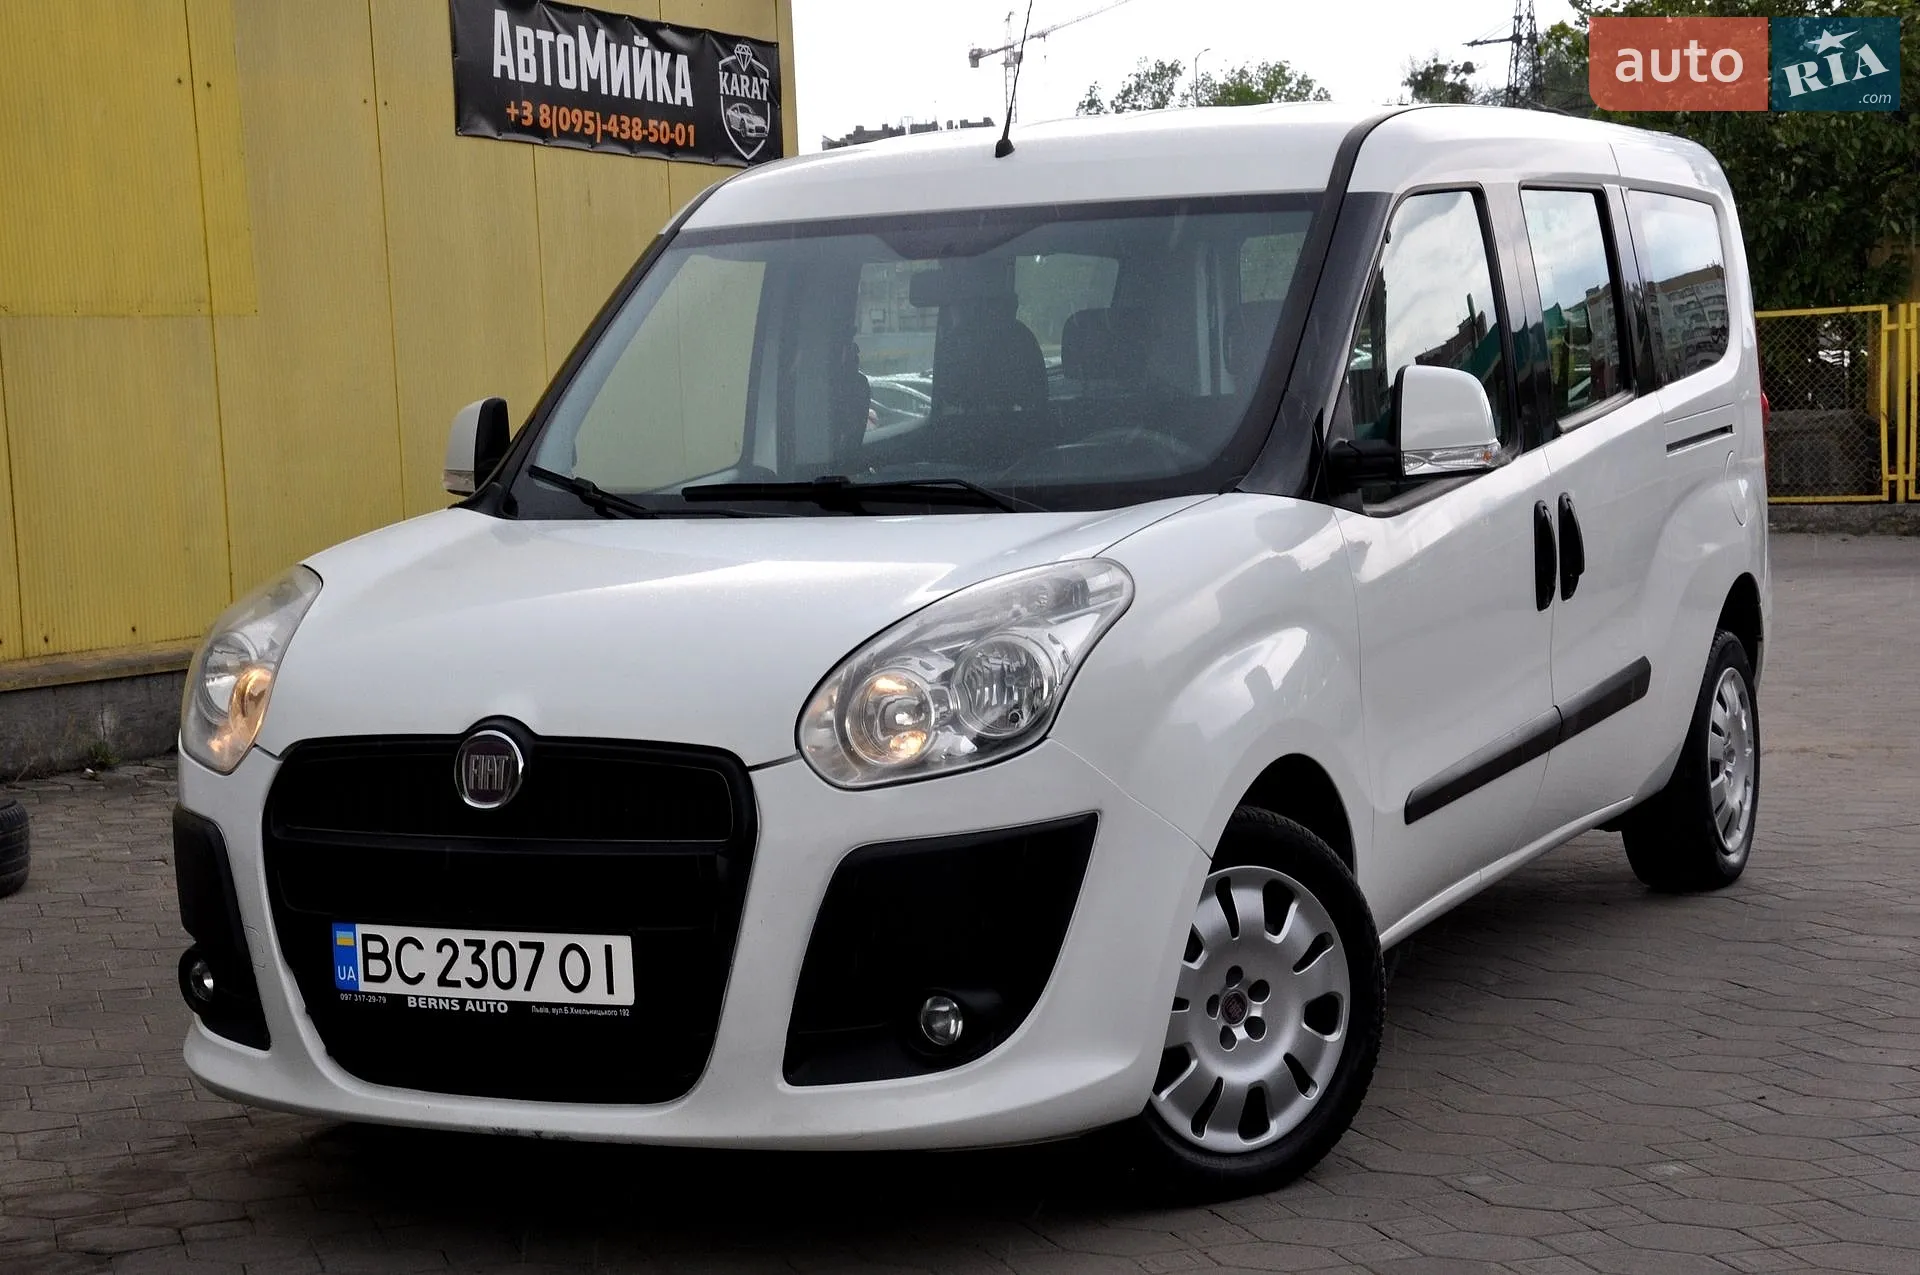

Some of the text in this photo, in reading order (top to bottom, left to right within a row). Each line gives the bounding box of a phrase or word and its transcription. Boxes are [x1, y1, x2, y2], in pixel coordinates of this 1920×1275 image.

[718, 70, 769, 101] KARAT
[468, 754, 509, 790] FIAT
[337, 965, 356, 981] UA
[361, 933, 426, 986] BC
[436, 937, 545, 993] 2307
[407, 996, 508, 1014] BERNS AUTO
